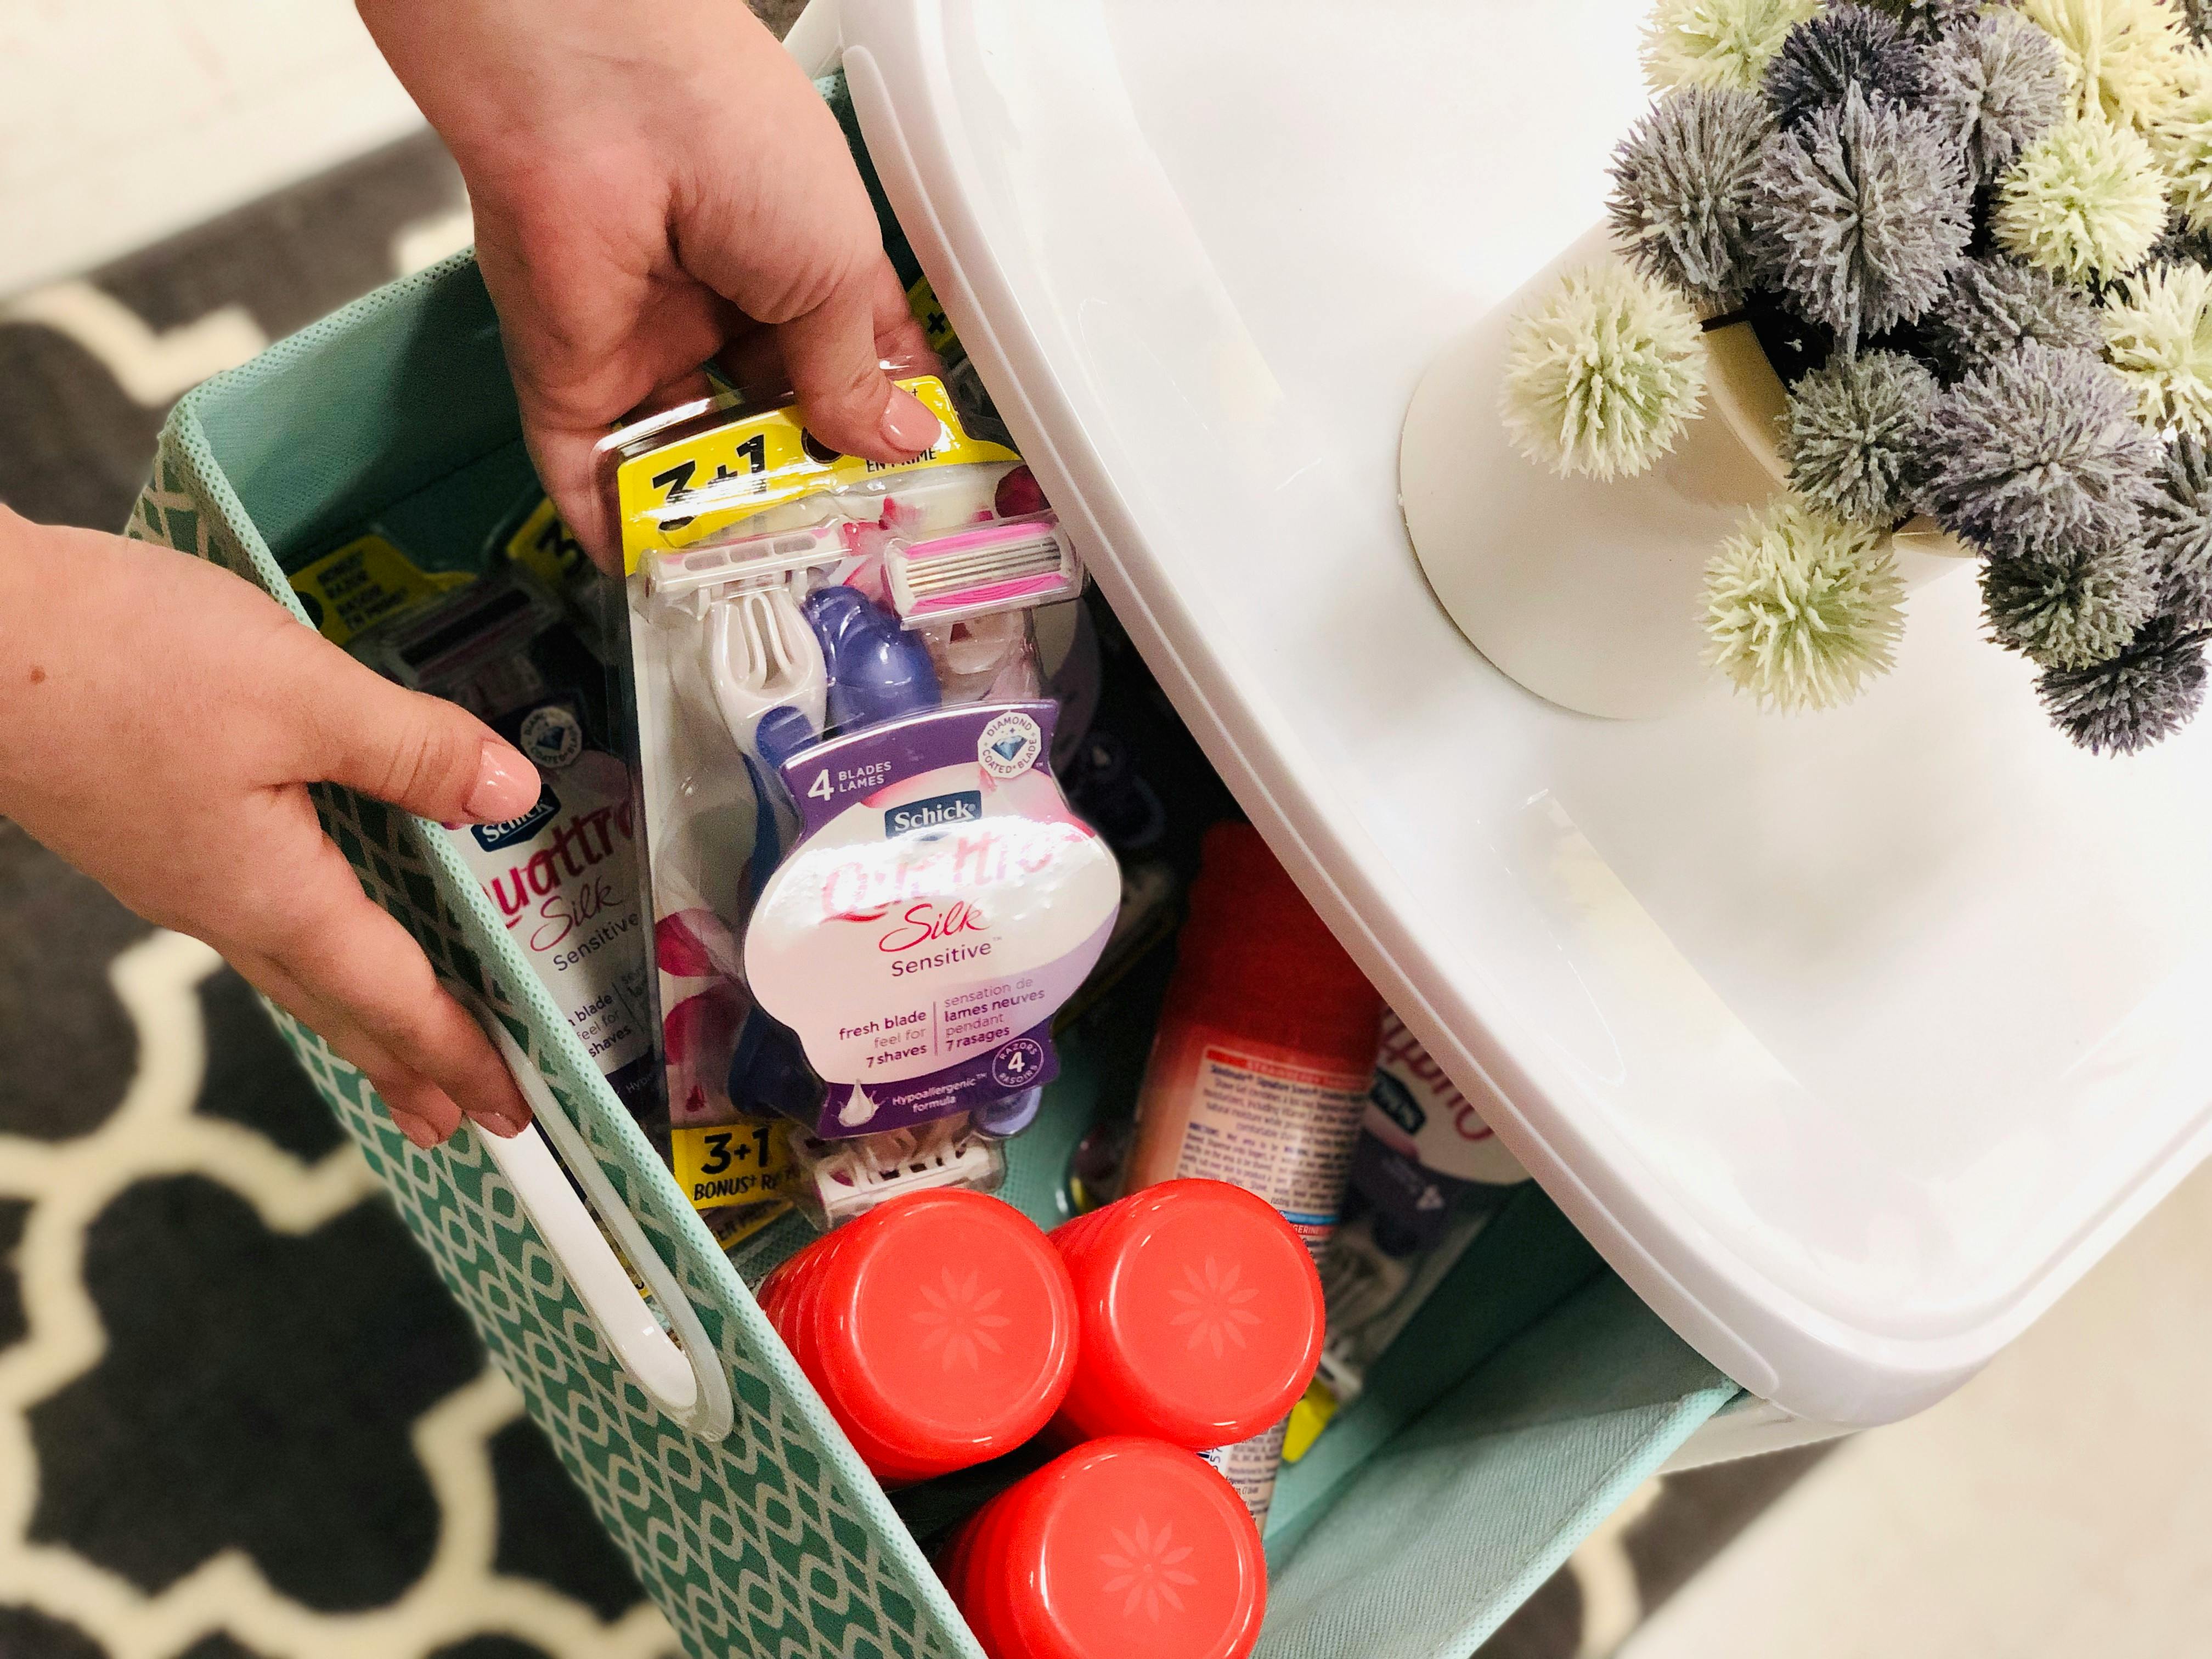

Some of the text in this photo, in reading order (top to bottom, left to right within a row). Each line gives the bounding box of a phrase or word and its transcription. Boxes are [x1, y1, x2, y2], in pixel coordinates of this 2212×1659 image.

[987, 716, 1032, 737] DIAMOND
[983, 738, 1037, 774] COATED BLADE
[808, 761, 892, 801] 4 BLADES
[839, 774, 885, 793] LAMES
[531, 876, 623, 951] Silk
[878, 900, 990, 952] Silk
[553, 912, 639, 972] Sensitive
[944, 978, 1033, 1007] sensation de
[945, 989, 1045, 1022] lames neuves
[577, 994, 613, 1023] blade
[839, 1011, 926, 1040] fresh blade
[874, 1026, 926, 1048] feel for
[946, 1013, 1003, 1038] pendant
[946, 1025, 1009, 1052] 7 rasages
[866, 1043, 927, 1069] 7 shaves
[1000, 1042, 1037, 1059] RAZORS
[1008, 1052, 1025, 1073] 4
[912, 1096, 956, 1113] formula
[701, 1128, 769, 1175] 3+1
